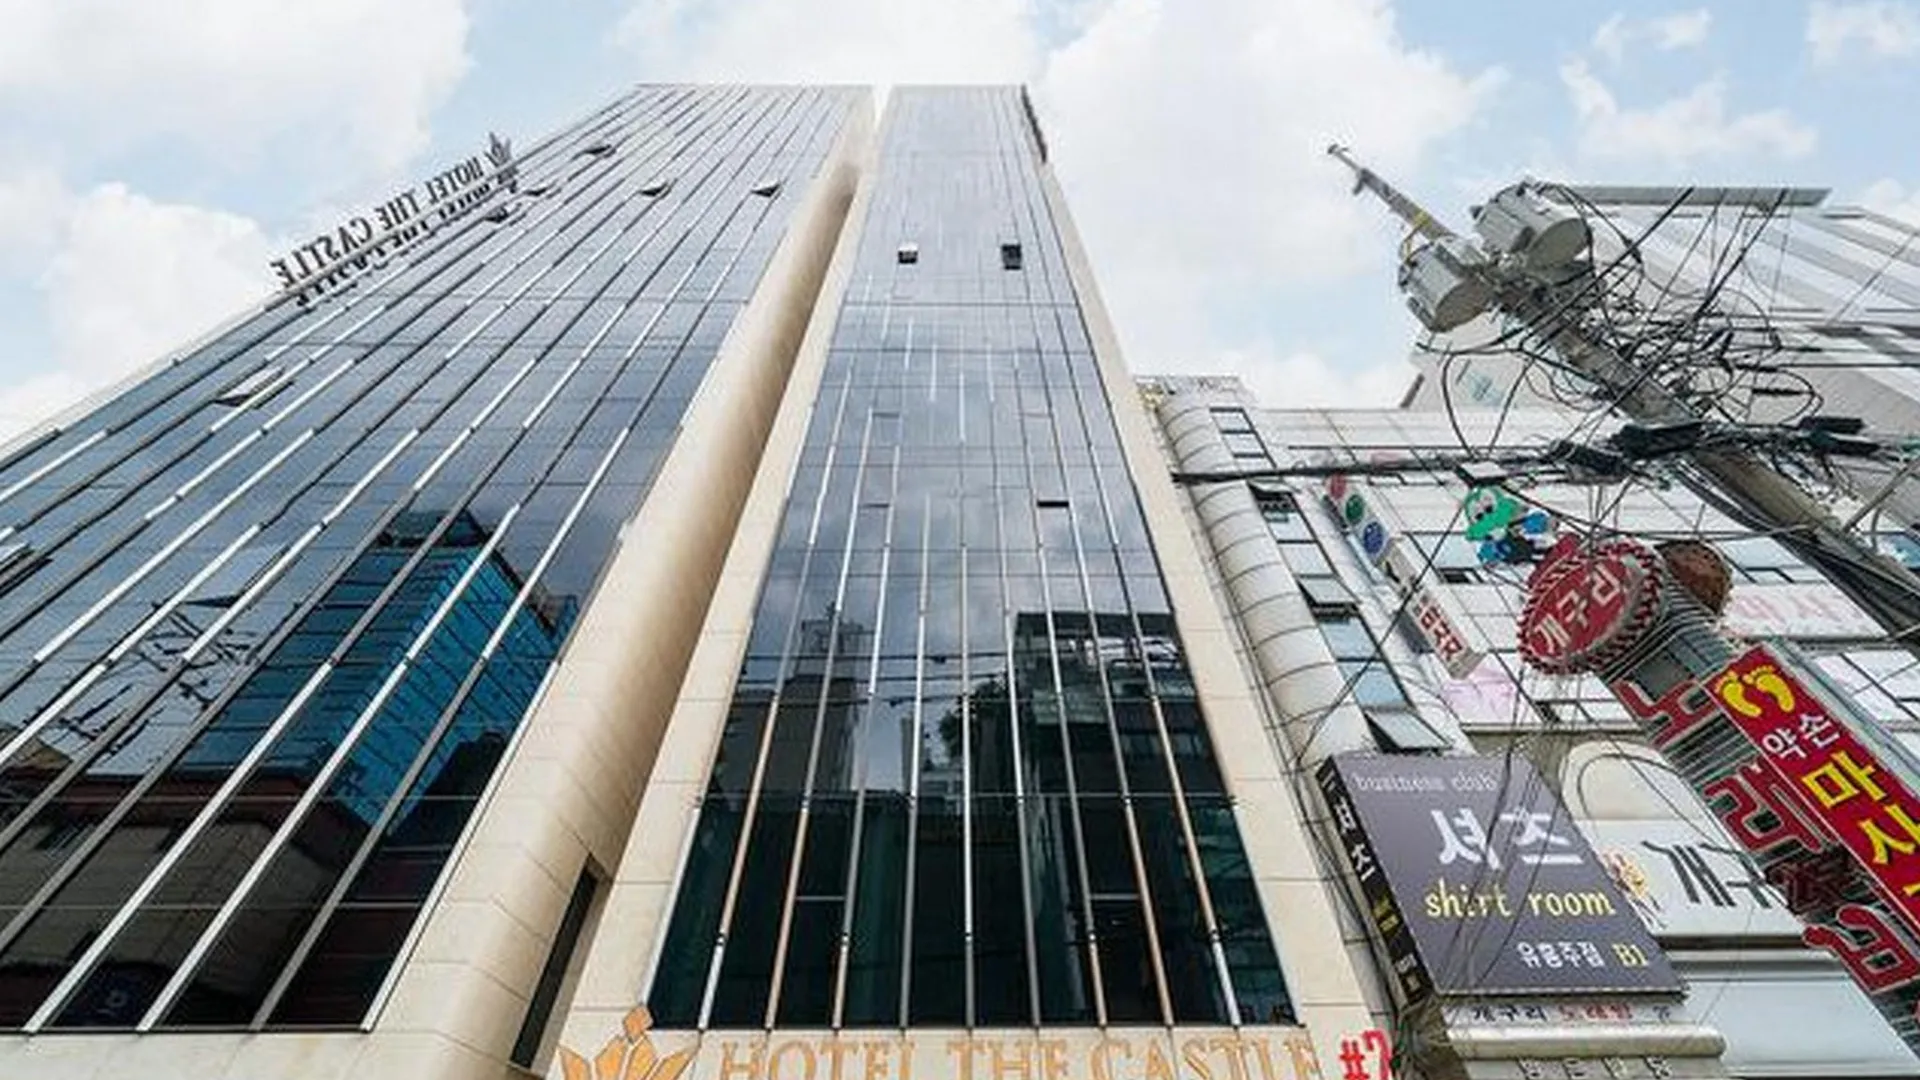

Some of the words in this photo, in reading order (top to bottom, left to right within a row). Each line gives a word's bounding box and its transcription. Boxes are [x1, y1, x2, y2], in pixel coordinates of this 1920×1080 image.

[1533, 561, 1622, 655] 개구리
[1801, 750, 1920, 897] 마사
[1423, 878, 1513, 918] shirt
[1527, 890, 1617, 917] room
[1517, 941, 1606, 969] 유흥주점
[1611, 941, 1650, 967] B1
[719, 1041, 916, 1080] HOTEL
[946, 1038, 1068, 1080] THE
[1090, 1036, 1322, 1080] CASTLE
